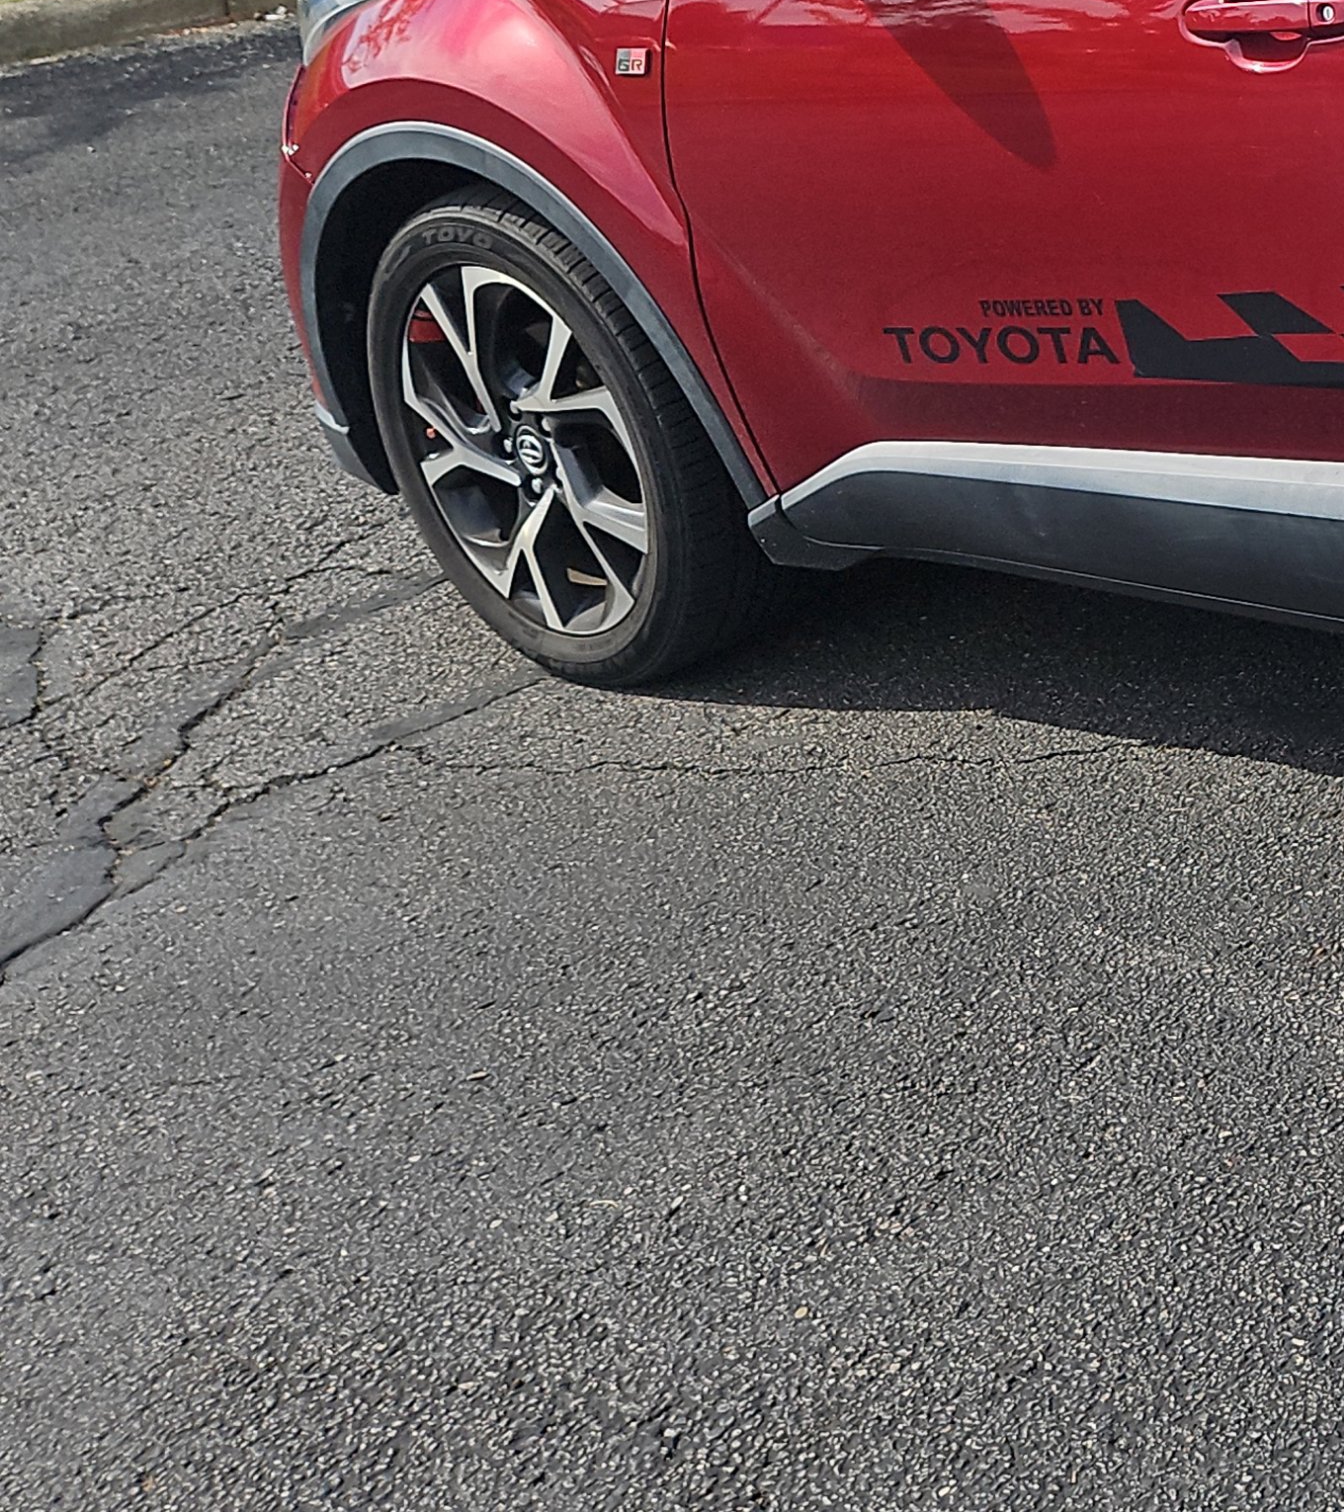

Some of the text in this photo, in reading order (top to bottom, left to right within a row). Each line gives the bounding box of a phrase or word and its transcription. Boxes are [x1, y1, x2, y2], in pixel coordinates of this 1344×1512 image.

[618, 58, 643, 72] GR
[422, 226, 494, 249] TOYO
[979, 298, 1104, 318] POWERED BY
[883, 325, 1121, 364] TOYOTA
